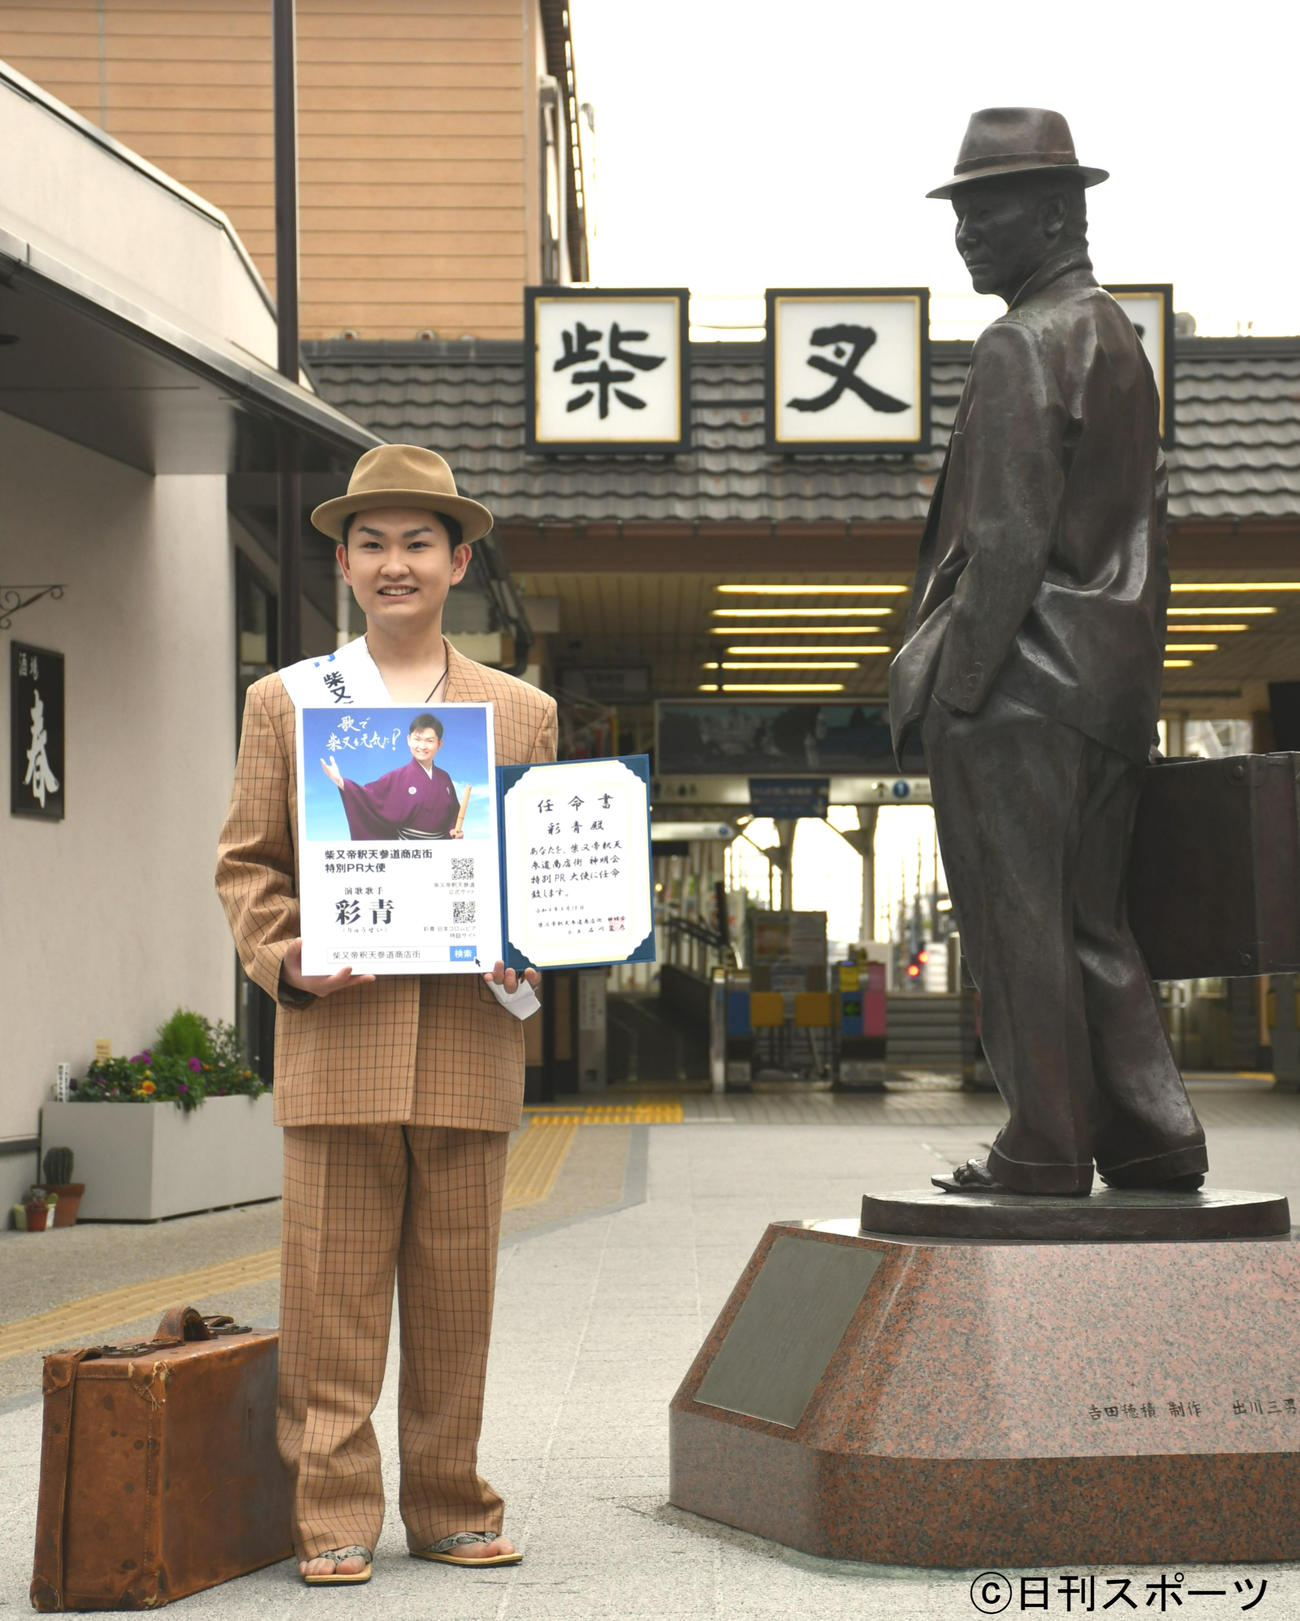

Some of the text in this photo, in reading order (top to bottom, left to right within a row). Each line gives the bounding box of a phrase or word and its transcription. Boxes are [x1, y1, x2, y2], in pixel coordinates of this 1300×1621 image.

[537, 793, 614, 814] 任命書
[324, 849, 433, 860] 柴又帝釈天参道商店街
[324, 863, 386, 873] 特別PR大使
[344, 887, 383, 896] 演歌歌手
[335, 899, 395, 926] 彩青
[332, 949, 473, 960] 柴又帝釈天参道商店街 検索
[1168, 1401, 1201, 1418] 制作
